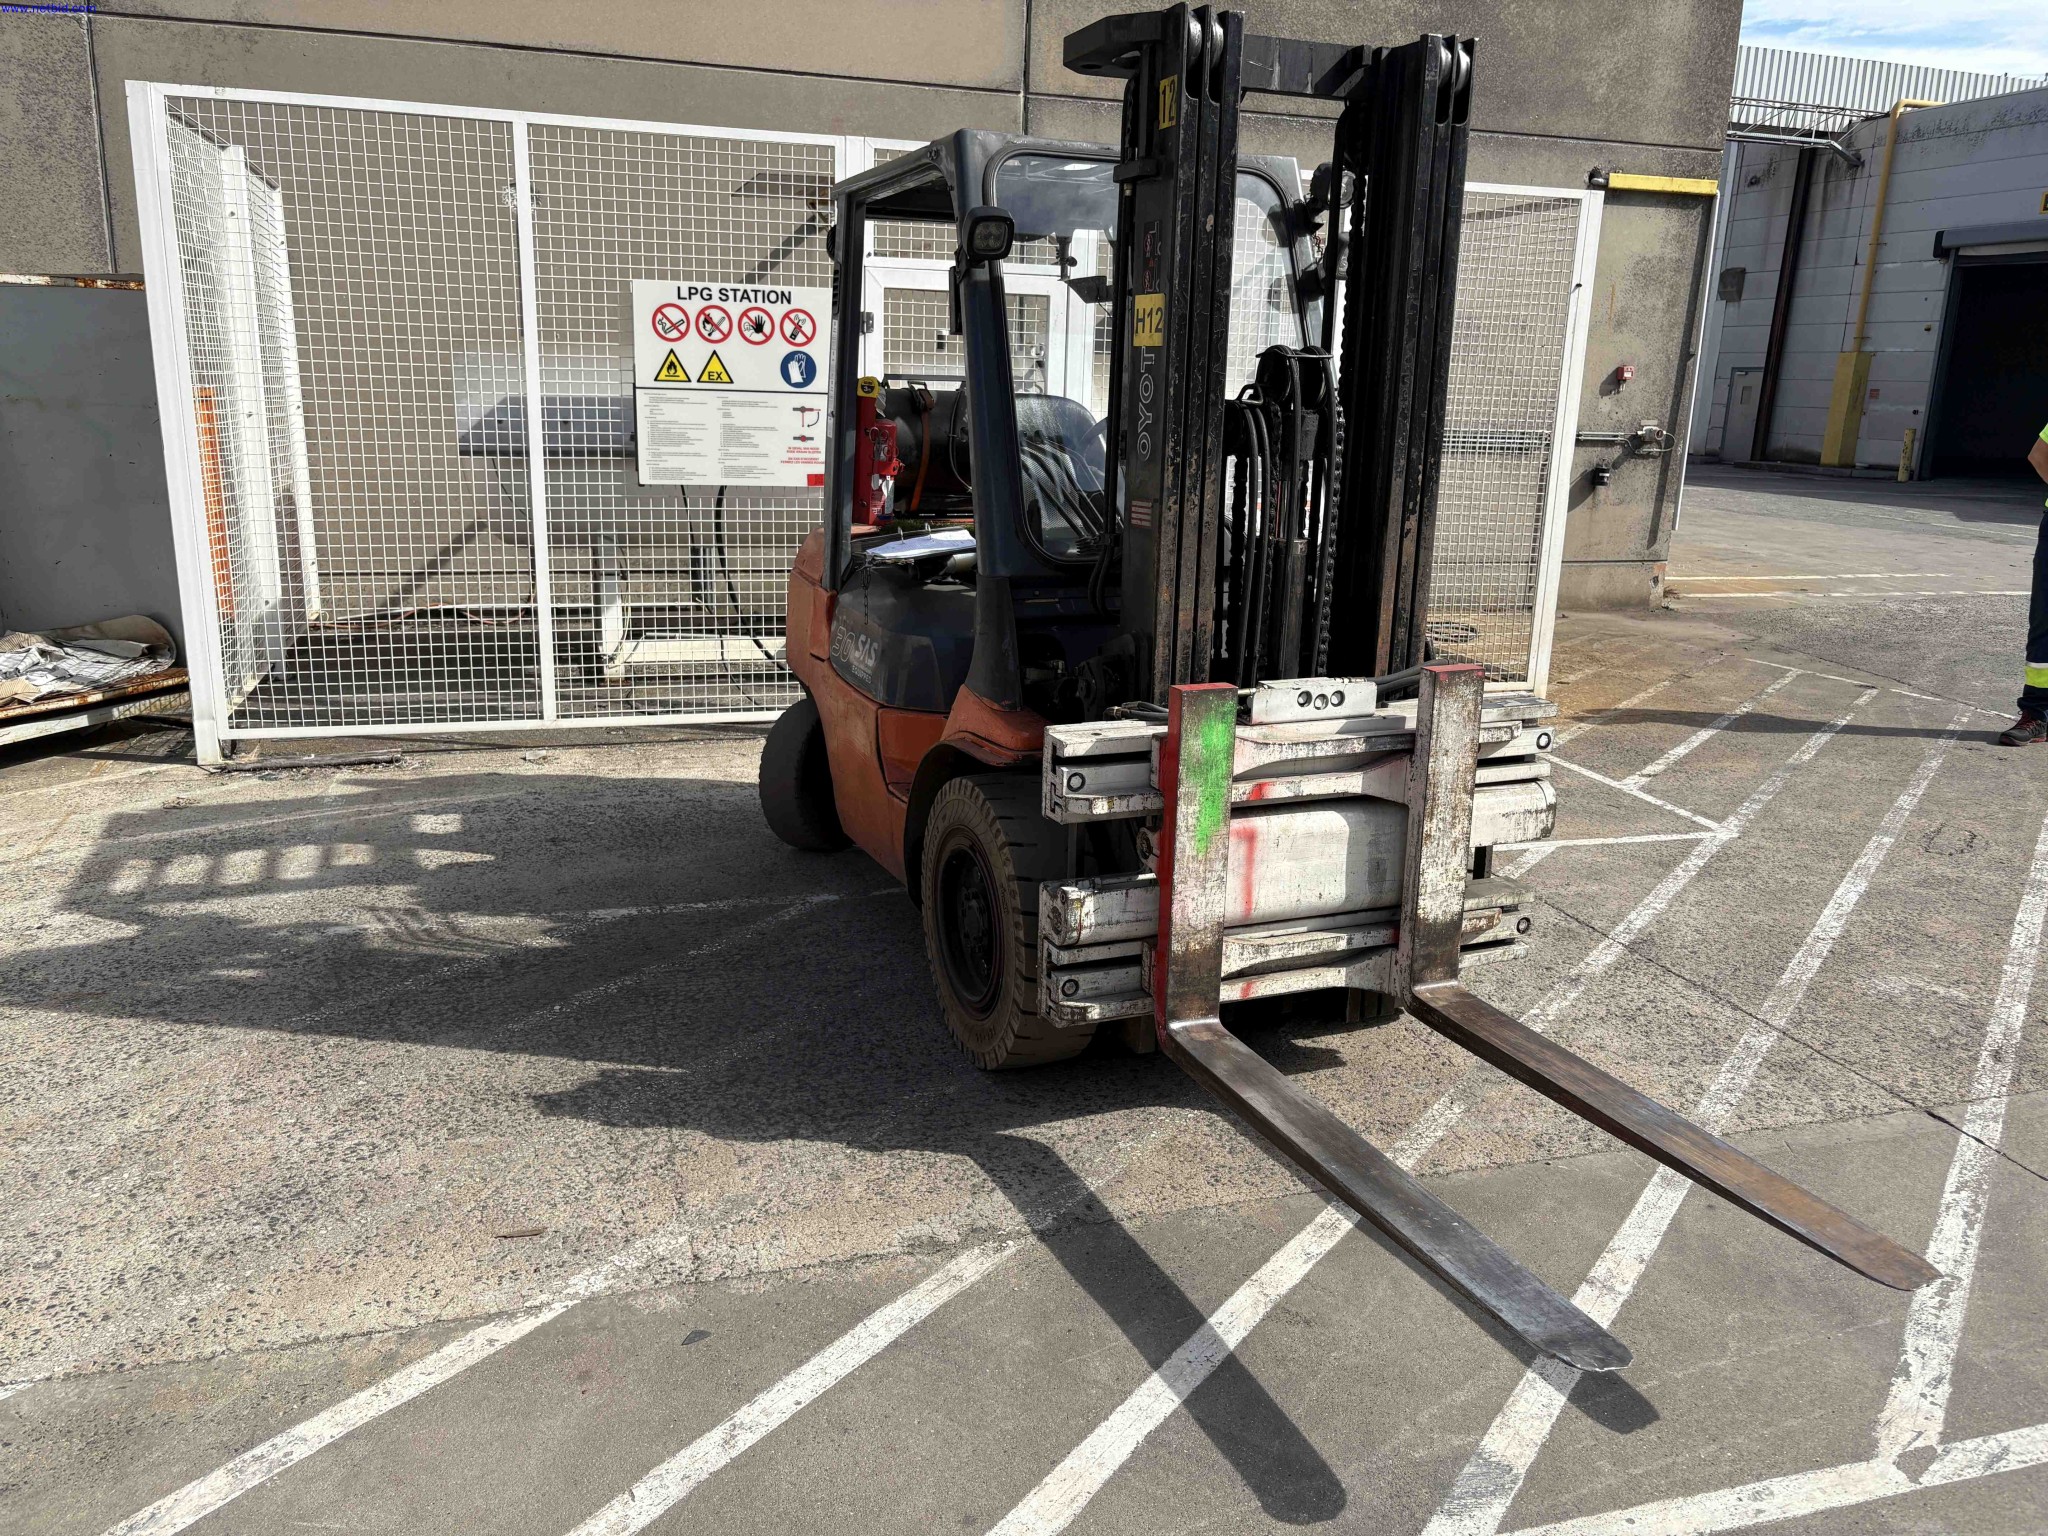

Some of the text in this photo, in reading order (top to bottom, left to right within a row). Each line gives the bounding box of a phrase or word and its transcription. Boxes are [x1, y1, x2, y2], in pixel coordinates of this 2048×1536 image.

[1161, 79, 1176, 124] 12
[677, 286, 792, 305] LPG STATION
[1135, 306, 1165, 334] H12
[707, 371, 723, 381] EX
[1137, 346, 1155, 462] OYOT
[855, 634, 879, 667] SAS
